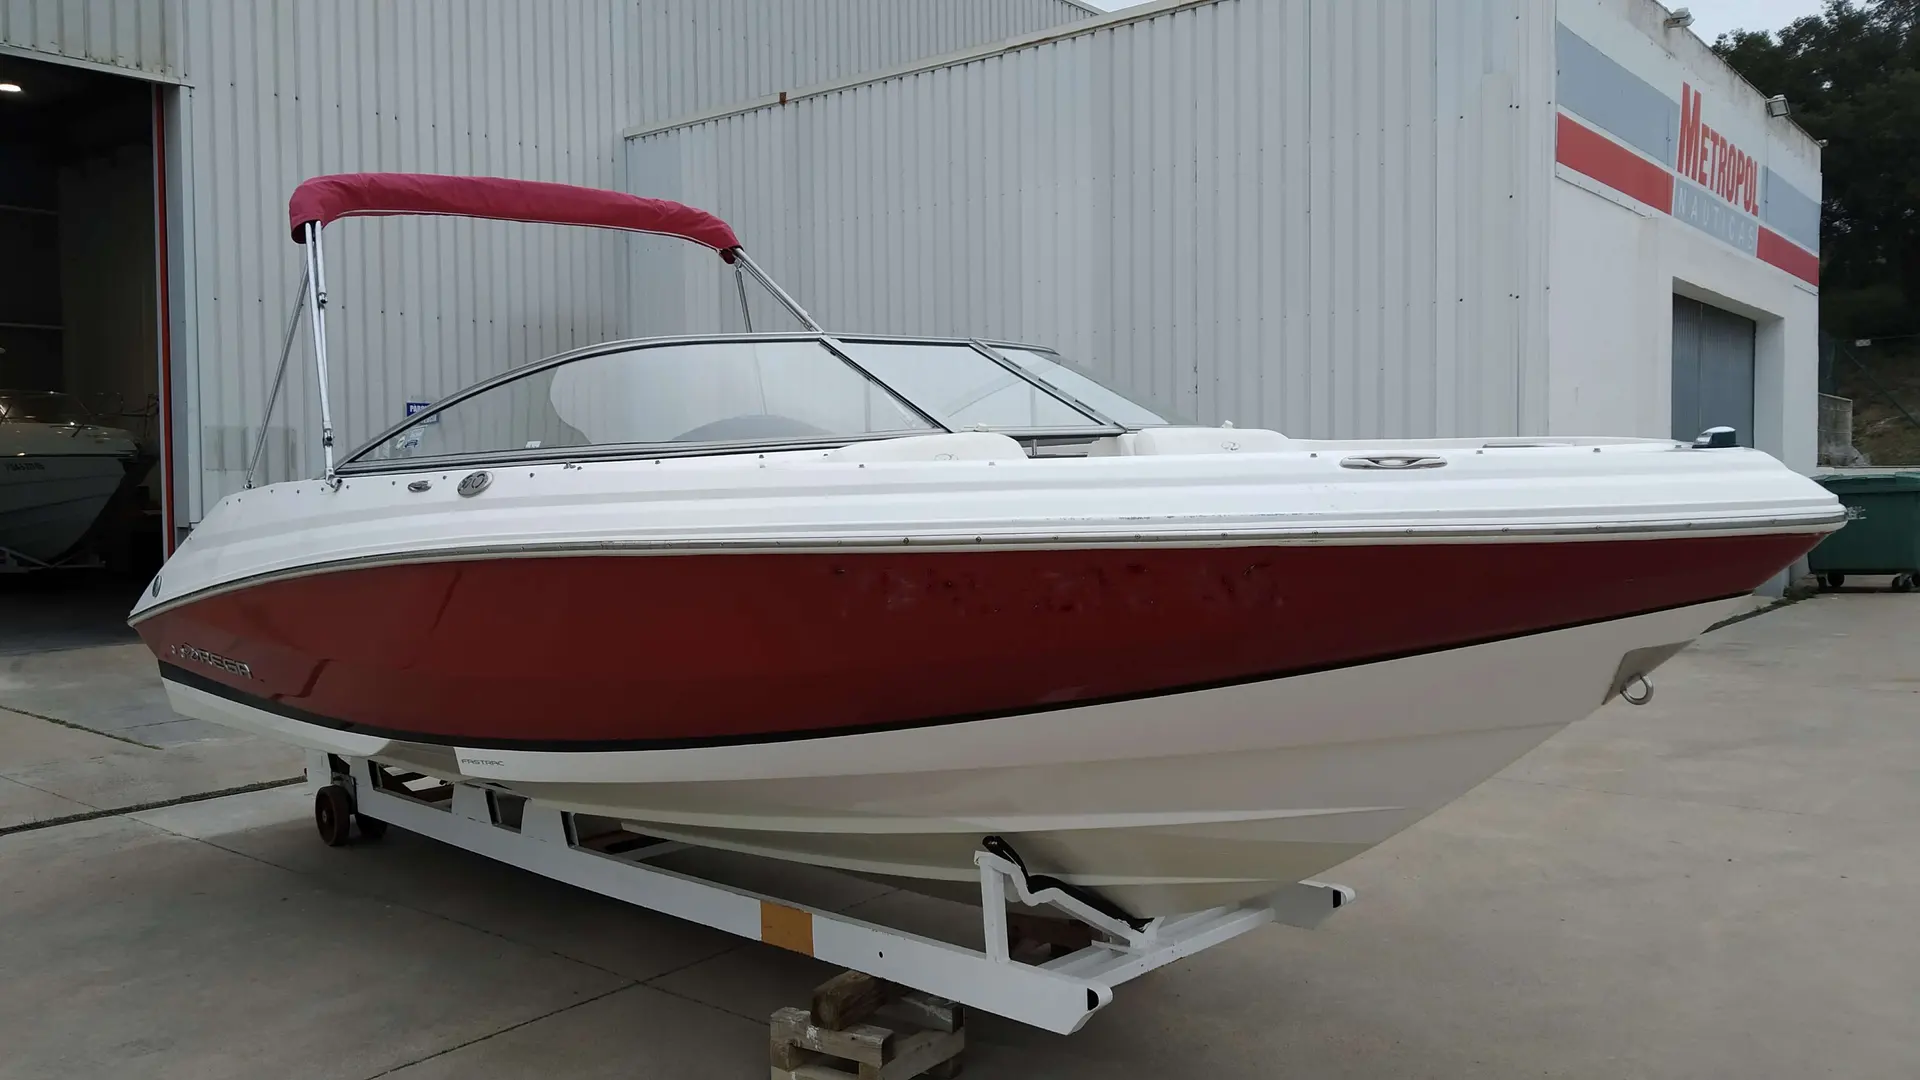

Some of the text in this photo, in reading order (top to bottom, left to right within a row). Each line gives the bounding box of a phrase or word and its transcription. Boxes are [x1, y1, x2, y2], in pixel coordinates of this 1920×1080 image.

[1676, 81, 1759, 218] METROPOL
[1678, 187, 1755, 250] NAUTICAS
[461, 758, 505, 767] FASTRAC
